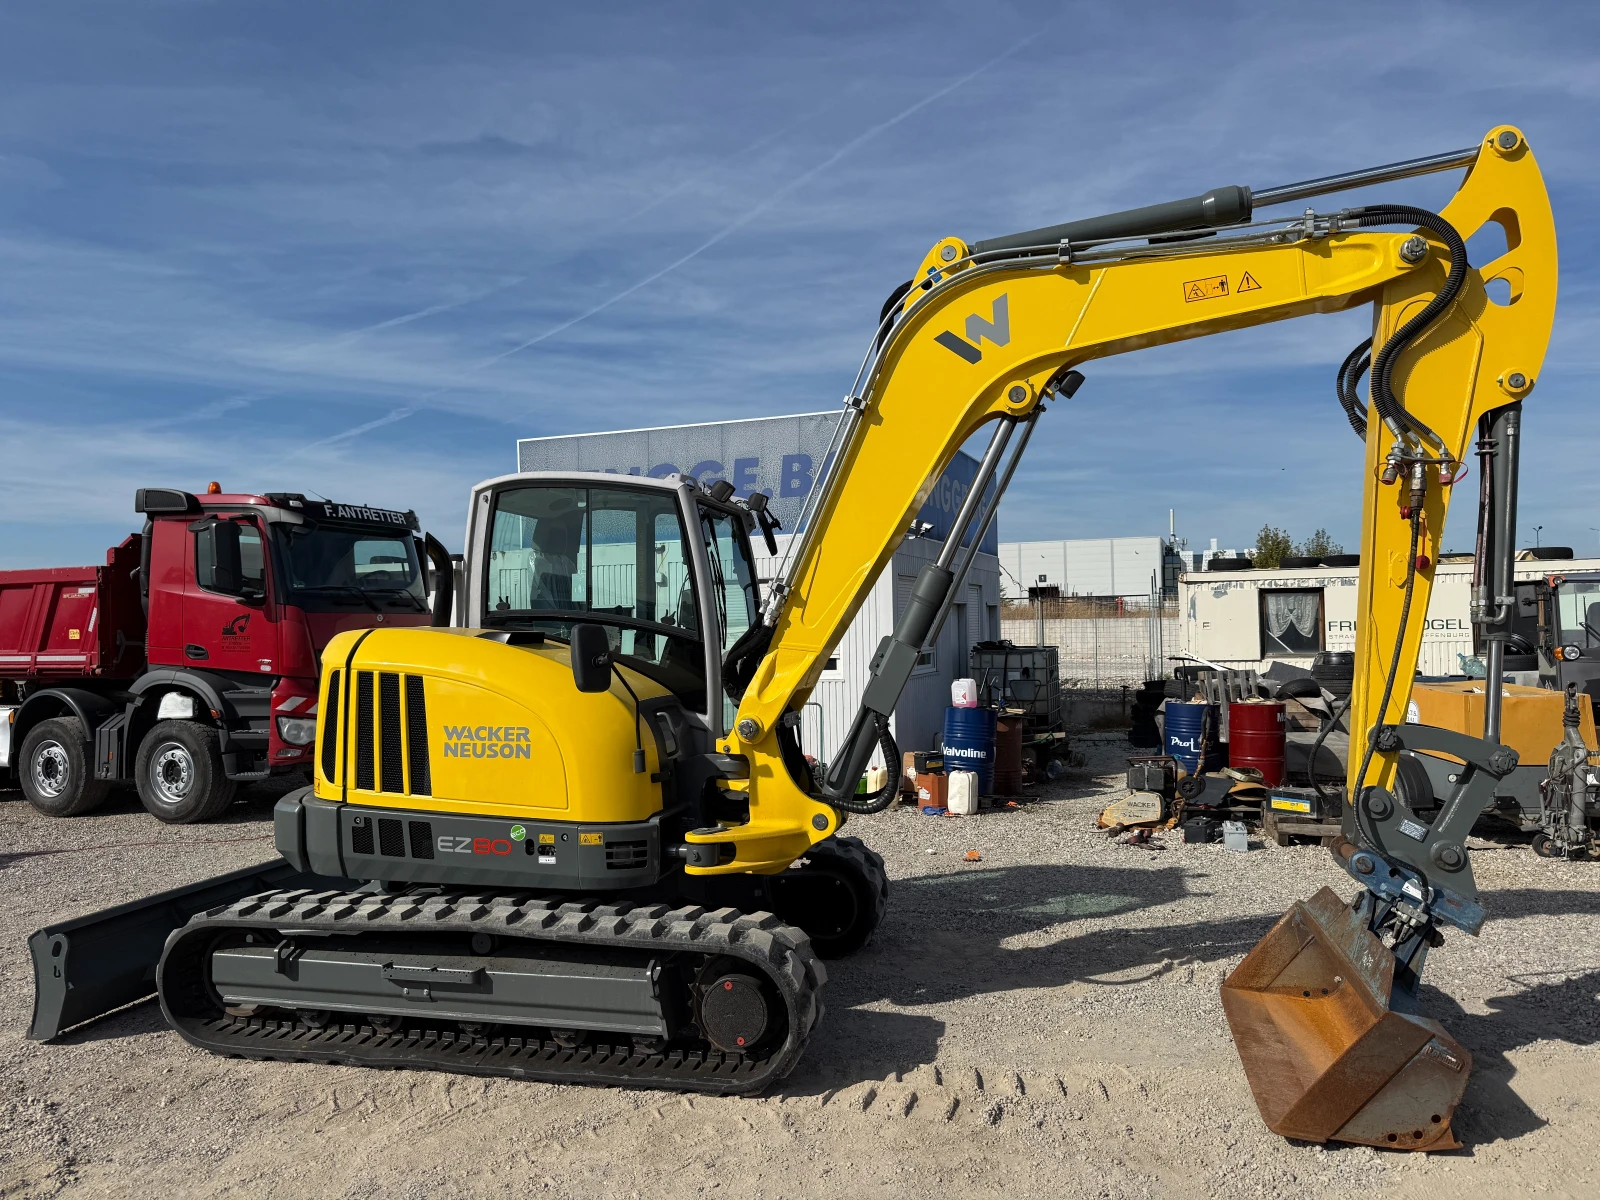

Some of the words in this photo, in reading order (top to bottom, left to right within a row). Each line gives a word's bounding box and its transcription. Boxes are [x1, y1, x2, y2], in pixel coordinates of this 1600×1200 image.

[443, 725, 531, 742] WACKER
[443, 742, 531, 759] NEUSON
[942, 747, 987, 759] Valvoline
[1126, 801, 1156, 809] WACKER
[437, 836, 512, 856] EZ80
